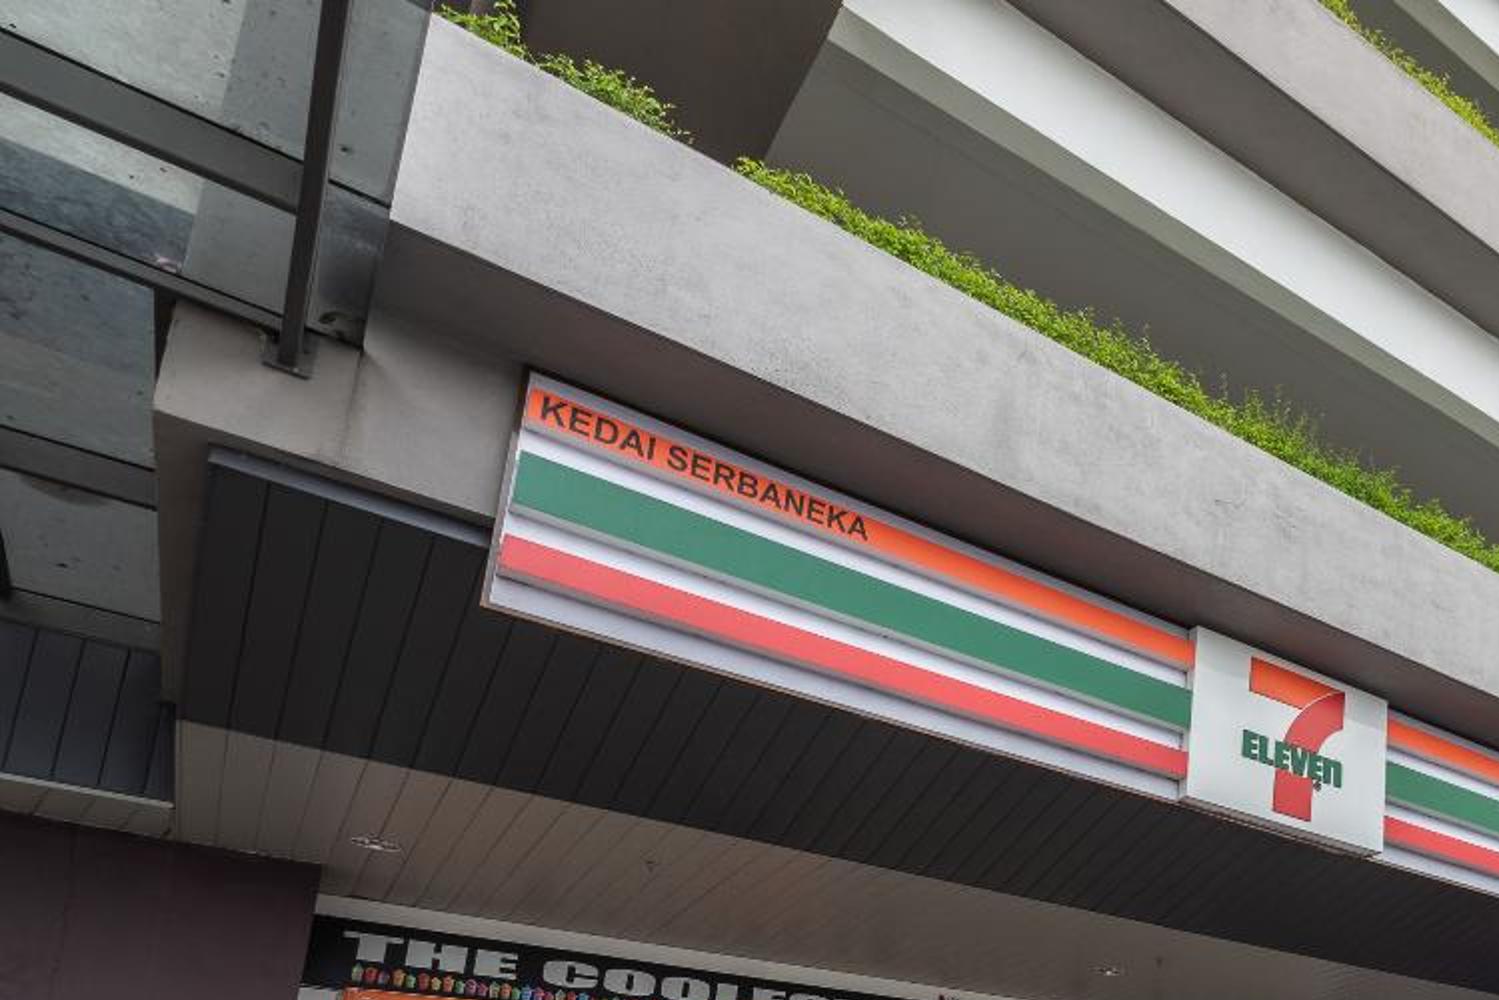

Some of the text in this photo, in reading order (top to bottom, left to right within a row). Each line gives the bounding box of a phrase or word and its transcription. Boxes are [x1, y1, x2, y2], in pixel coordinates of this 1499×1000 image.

[539, 394, 870, 542] KEDAI SERBANEKA
[1248, 655, 1346, 823] 7
[343, 930, 521, 978] THE
